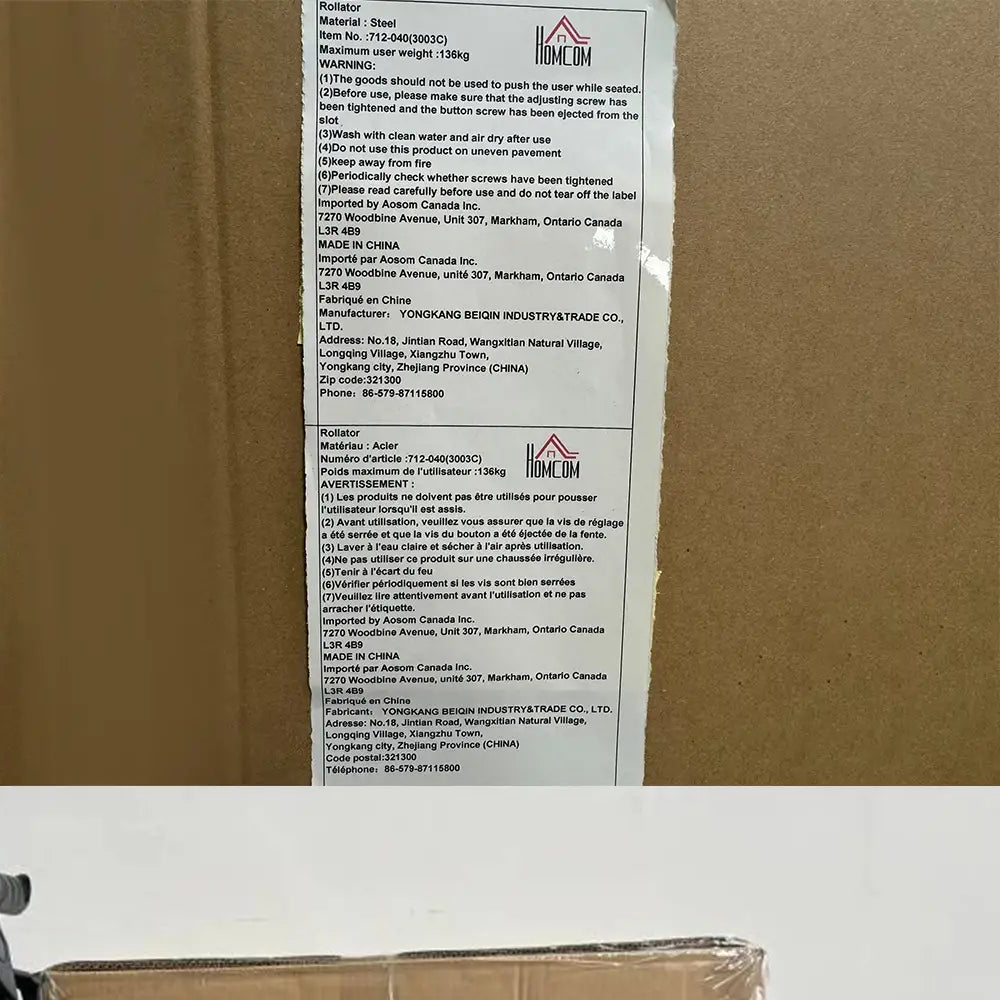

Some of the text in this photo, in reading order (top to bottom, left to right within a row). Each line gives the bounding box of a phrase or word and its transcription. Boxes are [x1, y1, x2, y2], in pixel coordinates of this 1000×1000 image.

[319, 2, 361, 12] Rollator
[319, 31, 342, 40] Item
[344, 32, 363, 41] No.
[535, 26, 591, 66] HOMCOM
[319, 45, 370, 56] Maximum
[398, 48, 433, 60] weight
[319, 59, 376, 68] WARNING:
[319, 74, 353, 85] (1)The
[354, 75, 388, 87] goods
[389, 77, 426, 86] should
[427, 79, 446, 87] not
[447, 79, 461, 87] be
[463, 80, 488, 89] used
[490, 81, 502, 89] to
[503, 81, 529, 92] push
[531, 82, 548, 90] the
[575, 83, 603, 92] while
[604, 84, 641, 94] seated.
[318, 129, 361, 141] (3)Wash
[363, 131, 385, 140] with
[387, 132, 415, 141] clean
[418, 133, 447, 141] water
[449, 133, 469, 142] and
[471, 134, 485, 142] air
[487, 134, 504, 145] dry
[506, 134, 530, 143] after
[318, 157, 432, 169] (5)keep away from fire
[318, 171, 391, 183] (6)Periodically
[393, 173, 425, 181] check
[426, 173, 469, 182] whether
[510, 175, 535, 184] have
[537, 176, 562, 185] been
[564, 177, 613, 188] tightened
[318, 199, 481, 210] Imported by Aosom Canada Inc.
[318, 240, 400, 249] MADE IN CHINA
[318, 254, 478, 266] Importé par Aosom Canada Inc.
[318, 282, 361, 290] L3R 4B9
[318, 295, 364, 306] Fabriqué
[381, 296, 412, 305] Chine
[319, 336, 603, 350] Address: No.18, Jintian Road, Wangxitian Natural Village,
[319, 362, 529, 374] Yongkang city, Zhejiang Province (CHINA)
[319, 376, 402, 386] Zip code:321300
[362, 388, 444, 397] 86-579-87115800
[320, 429, 360, 437] Rollator
[320, 455, 360, 463] Numéro
[362, 455, 402, 463] d'article
[526, 443, 579, 479] HOMCOM
[320, 467, 349, 475] Poids
[351, 467, 400, 475] maximum
[402, 467, 415, 475] de
[416, 467, 472, 475] l'utilisateur
[321, 567, 433, 578] (5)Tenir à l'écart du feu
[371, 579, 448, 590] périodiquement
[449, 579, 459, 587] si
[460, 579, 475, 587] les
[476, 579, 492, 587] vis
[493, 579, 516, 587] sont
[517, 578, 538, 586] bien
[539, 578, 576, 586] serrées
[354, 652, 366, 660] IN
[367, 652, 400, 660] CHINA
[369, 719, 399, 728] No.18,
[400, 719, 433, 727] Jintian
[434, 718, 462, 728] Road,
[463, 717, 516, 727] Wangxitian
[517, 717, 551, 725] Natural
[552, 716, 587, 726] Village,
[326, 754, 417, 763] Code postal:321300
[384, 764, 460, 772] 86-579-87115800
